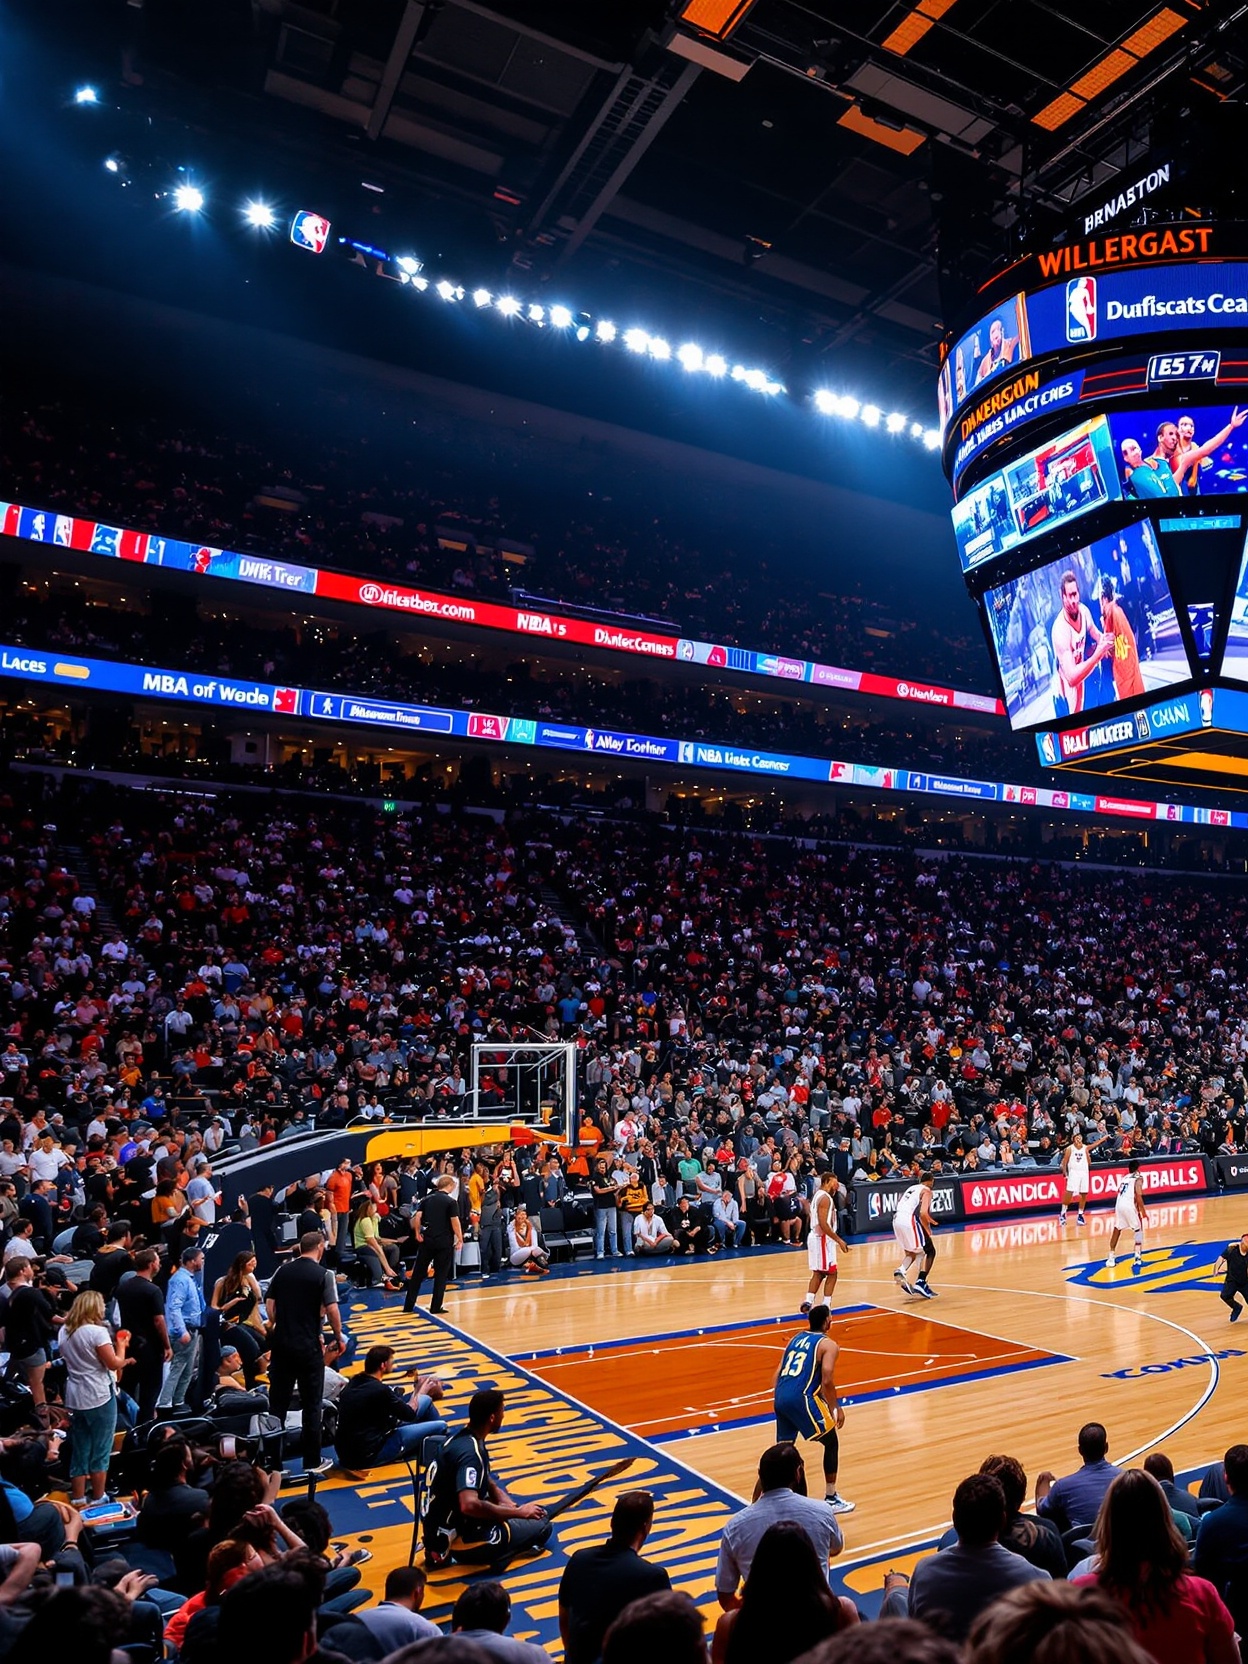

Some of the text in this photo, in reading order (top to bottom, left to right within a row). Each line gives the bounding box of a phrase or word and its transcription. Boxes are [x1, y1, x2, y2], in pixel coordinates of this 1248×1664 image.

[1038, 228, 1213, 278] WILLERGAST
[142, 672, 189, 696] MBA
[781, 1350, 807, 1377] 13
